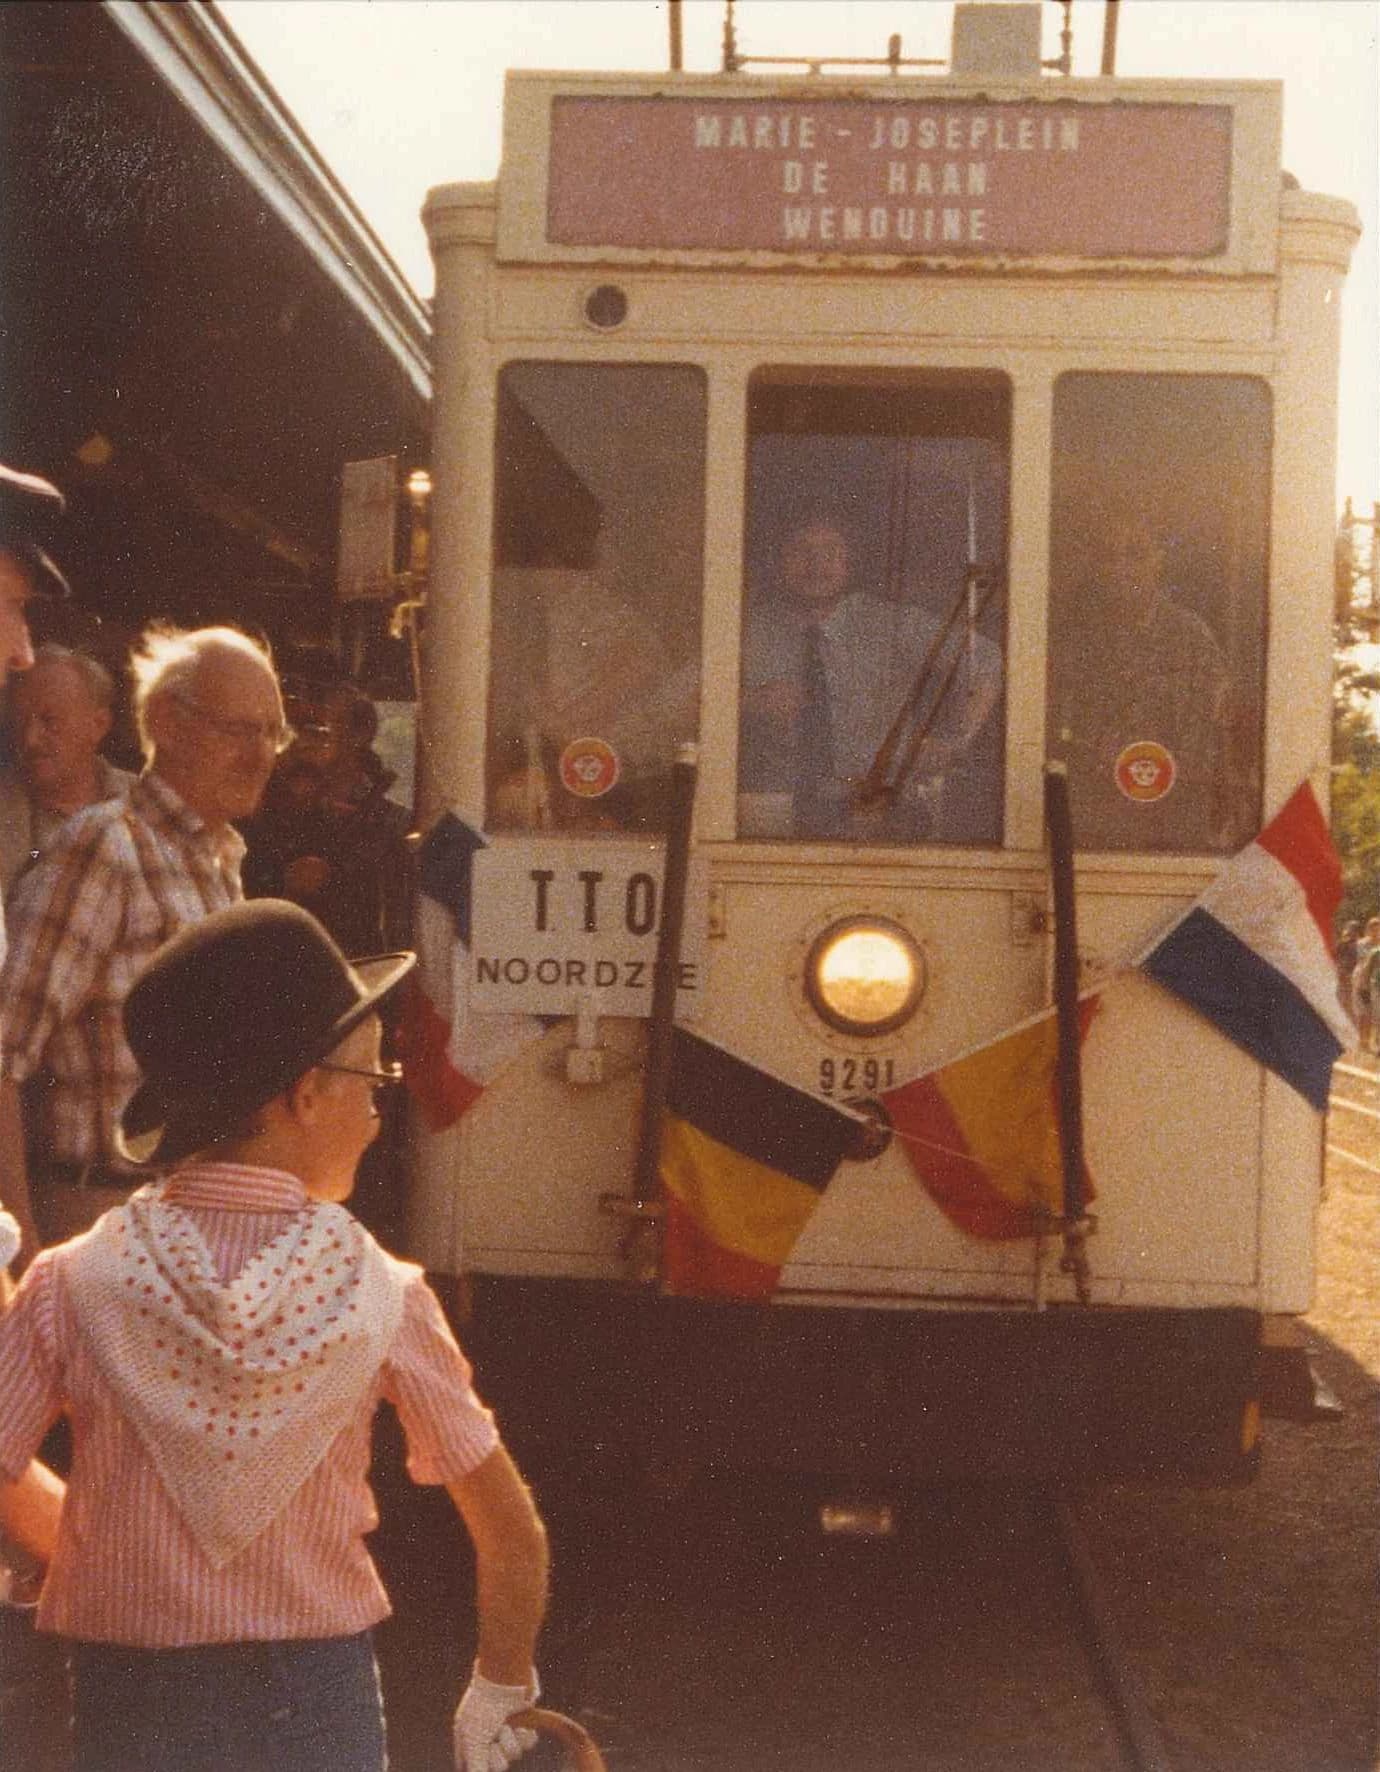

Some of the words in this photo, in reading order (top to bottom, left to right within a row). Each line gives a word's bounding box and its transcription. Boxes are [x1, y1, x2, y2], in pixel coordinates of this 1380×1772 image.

[693, 116, 815, 148] MARIE
[869, 115, 1079, 149] JOSEPLEIN
[784, 160, 828, 194] DE
[887, 160, 987, 195] HAAN
[530, 870, 655, 936] TTO
[476, 957, 697, 990] NOORDZE
[820, 1058, 894, 1091] 9291
